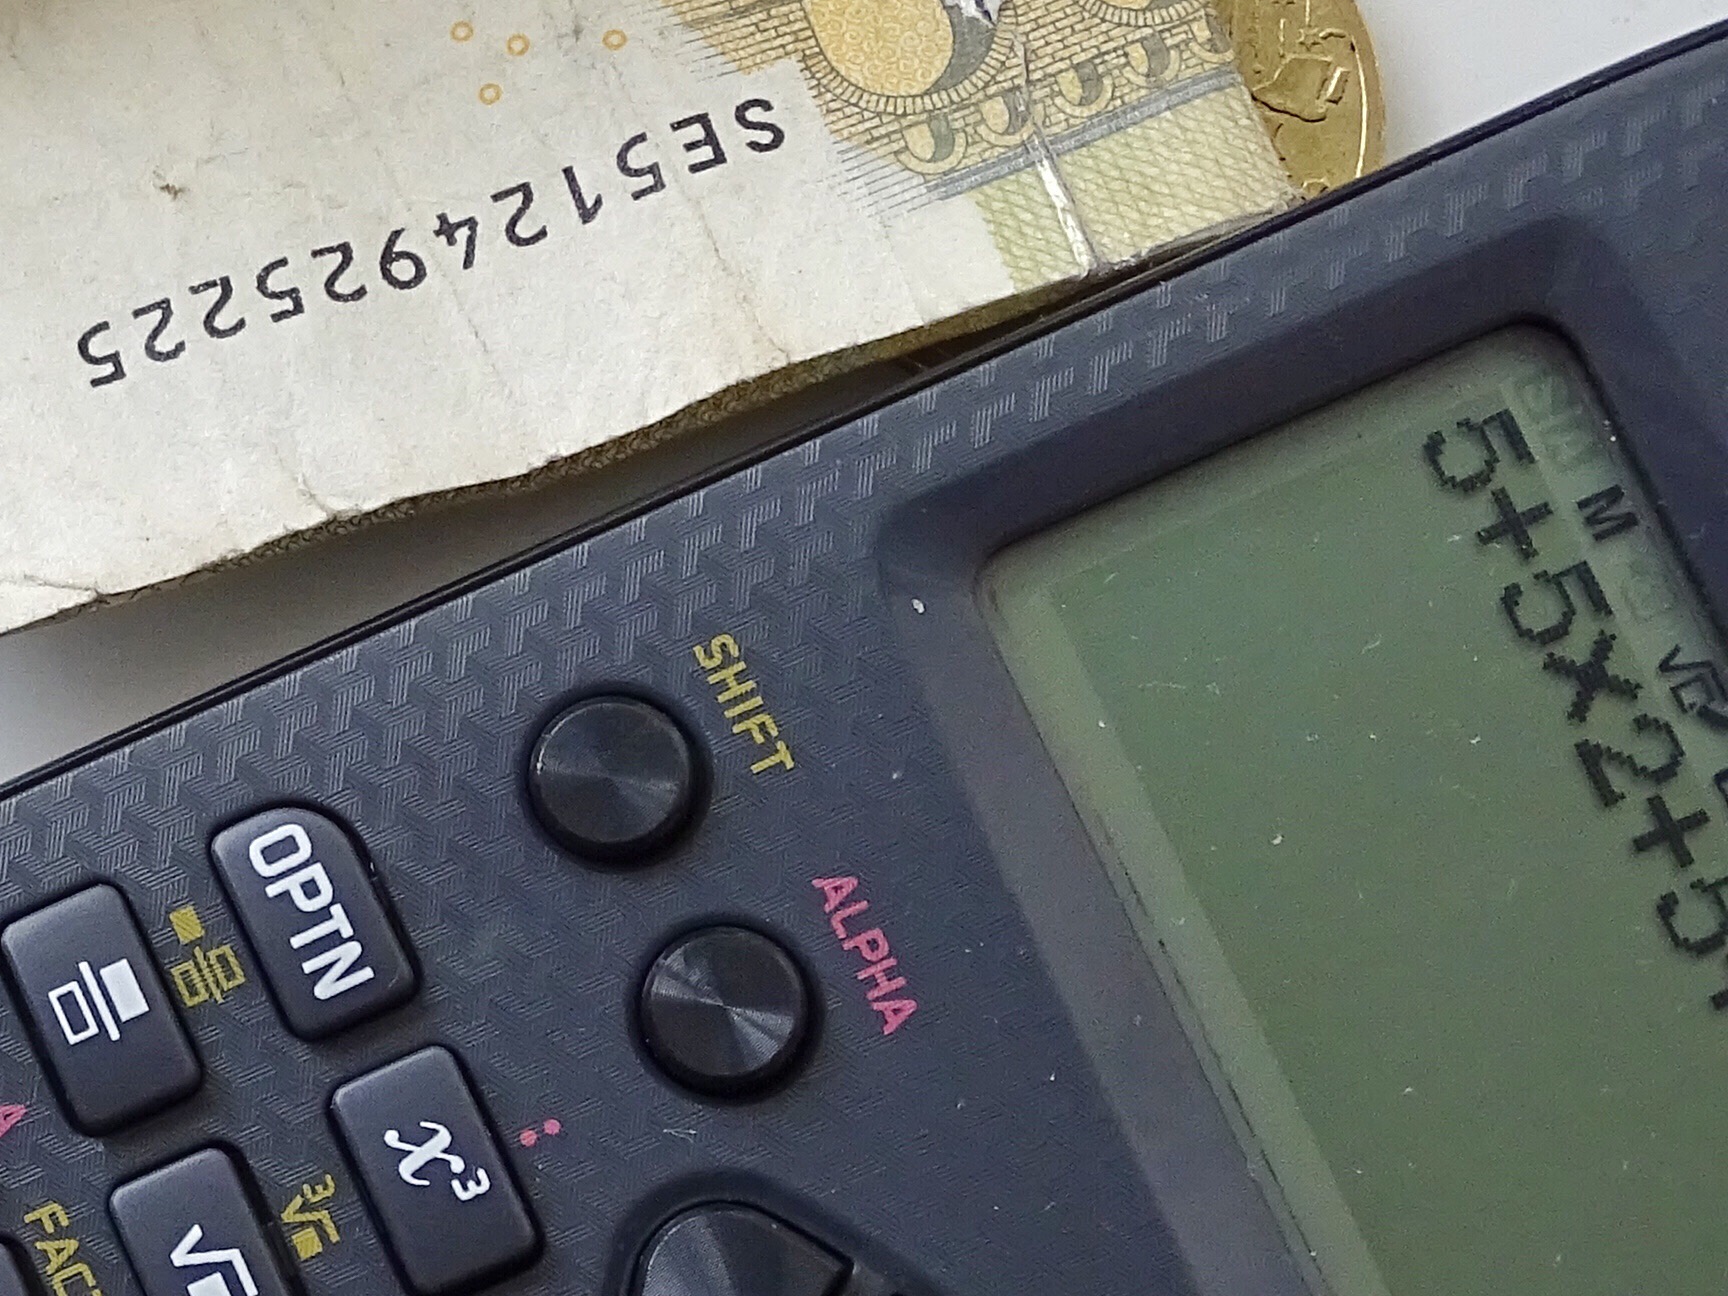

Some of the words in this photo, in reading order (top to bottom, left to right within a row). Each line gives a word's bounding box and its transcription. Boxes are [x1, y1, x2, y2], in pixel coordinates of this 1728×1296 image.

[76, 97, 787, 390] SE5124925225
[1576, 483, 1641, 542] M
[692, 631, 796, 777] SHIFT
[247, 821, 376, 1003] OPTN
[812, 875, 919, 1036] ALPHA
